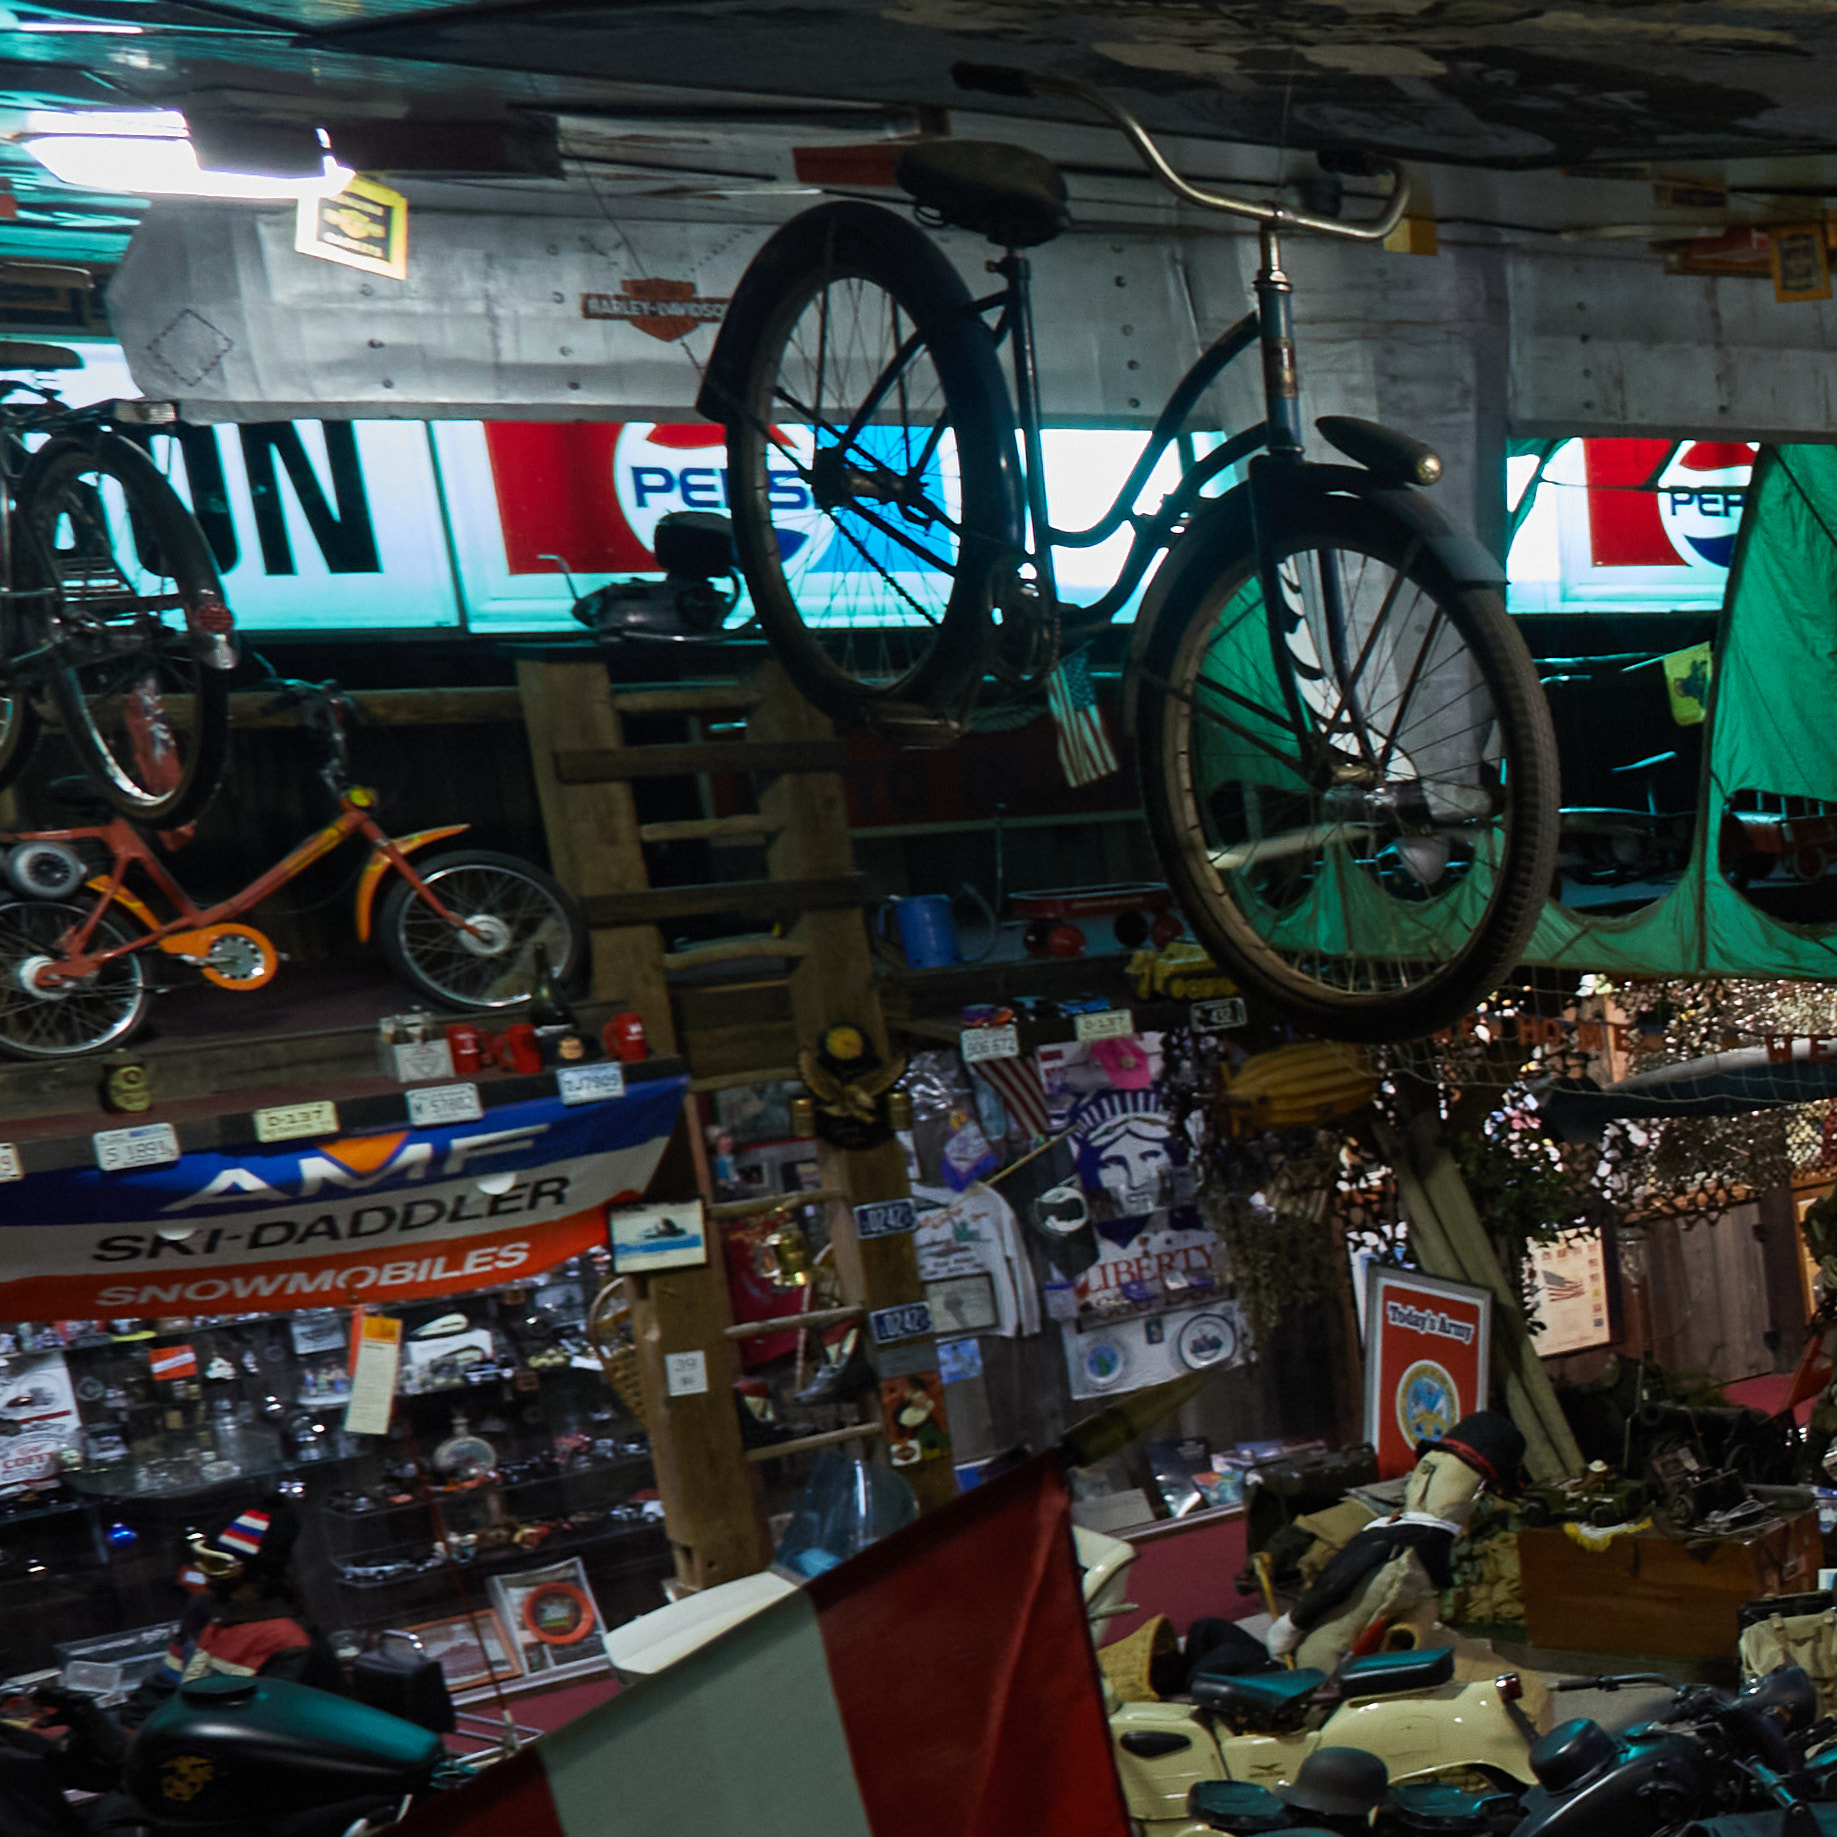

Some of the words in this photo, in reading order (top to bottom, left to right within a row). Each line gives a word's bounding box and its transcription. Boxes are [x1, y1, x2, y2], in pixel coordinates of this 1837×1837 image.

[587, 301, 728, 317] HARLEY-DAVIDSO
[159, 1122, 554, 1213] AMF
[94, 1176, 570, 1263] SKI-DADDLER
[94, 1242, 532, 1308] SNOWMOBILES
[1087, 1243, 1218, 1294] LIBERTY
[1388, 1304, 1437, 1334] Today's
[1438, 1315, 1473, 1344] Army
